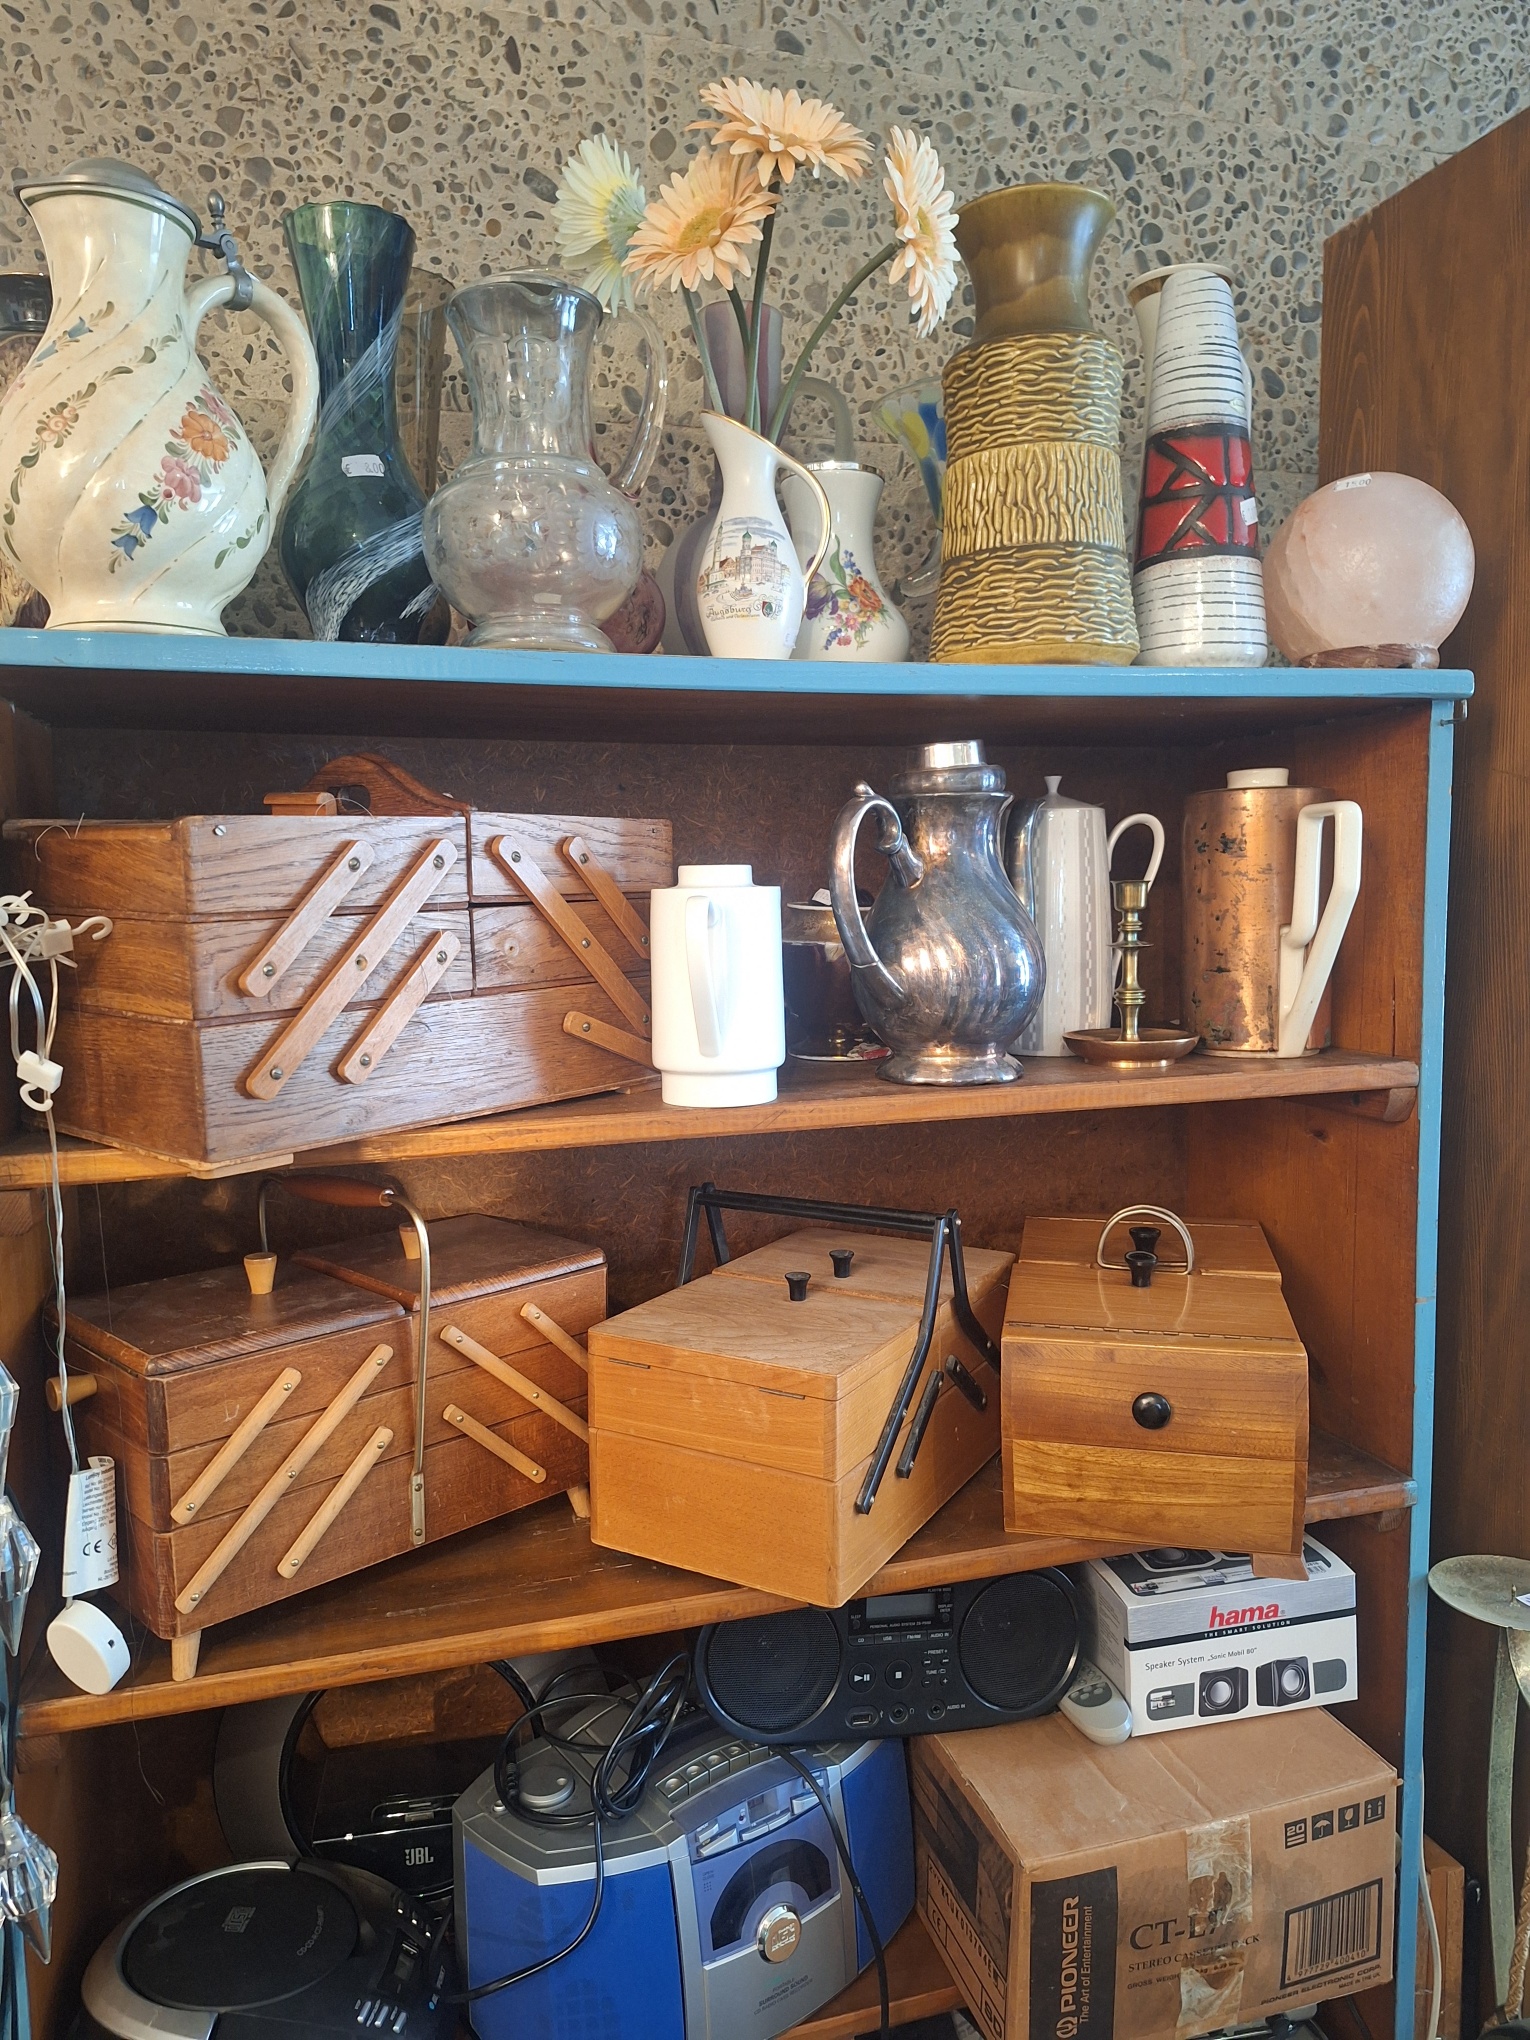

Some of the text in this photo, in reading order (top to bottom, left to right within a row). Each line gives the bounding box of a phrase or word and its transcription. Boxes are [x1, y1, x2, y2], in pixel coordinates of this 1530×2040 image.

[83, 1539, 102, 1556] CE
[1209, 1603, 1280, 1629] hama
[1223, 1627, 1248, 1636] SMART
[1252, 1620, 1291, 1631] SOLUTION
[1145, 1660, 1176, 1672] Speaker
[1177, 1655, 1205, 1667] System
[1227, 1649, 1245, 1658] Mobil
[1287, 1823, 1305, 1836] 20
[405, 1847, 434, 1866] JBL
[1060, 1895, 1079, 2013] PIONEER
[1080, 1905, 1093, 2023] The Art of Entertainment
[1128, 1956, 1172, 1973] STEREO
[759, 1975, 809, 2007] SURROUND SOUND
[1127, 1979, 1153, 1990] GROSS
[1260, 1989, 1299, 2006] PIONEER
[1301, 1972, 1355, 1993] ELECTRONIC
[1338, 1981, 1354, 1990] MADE
